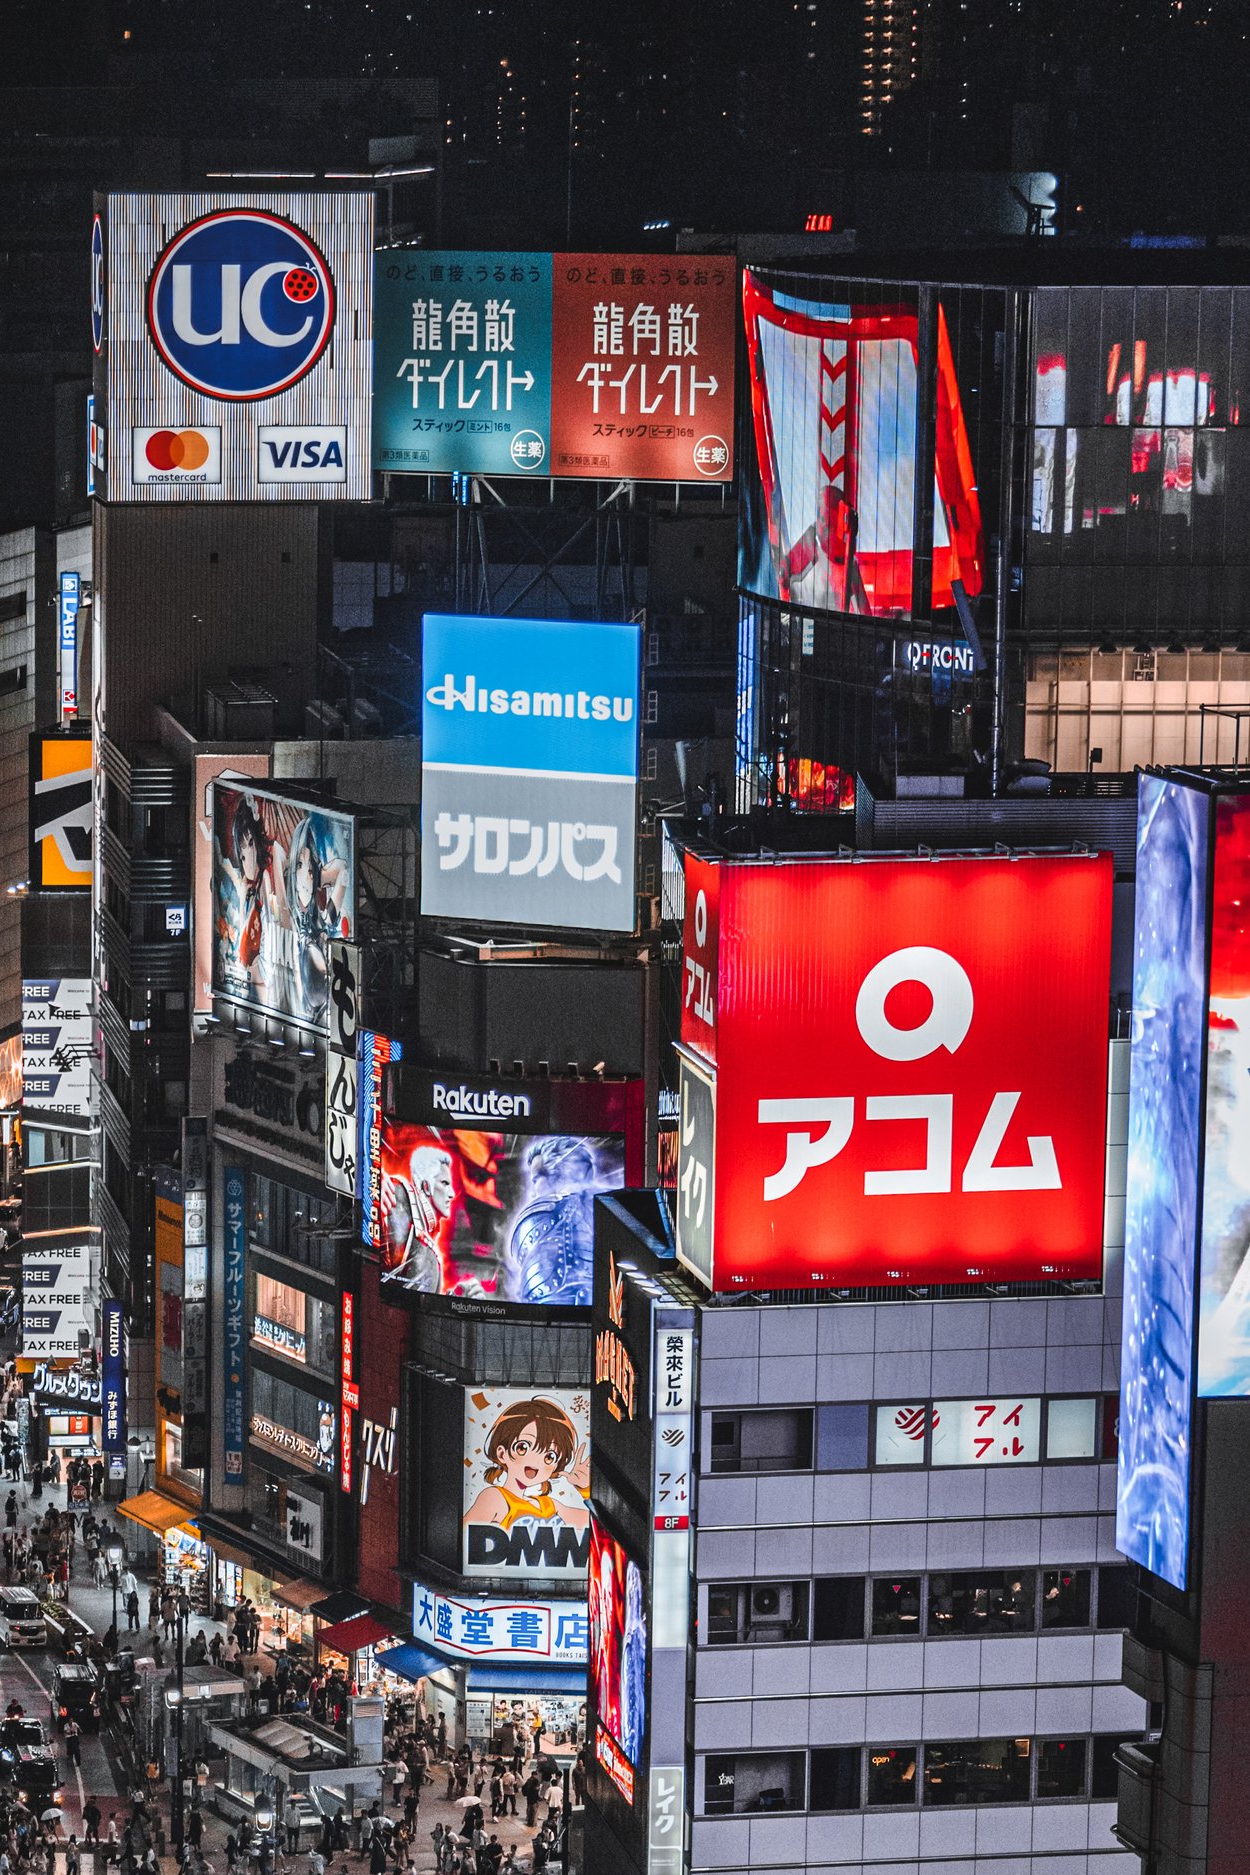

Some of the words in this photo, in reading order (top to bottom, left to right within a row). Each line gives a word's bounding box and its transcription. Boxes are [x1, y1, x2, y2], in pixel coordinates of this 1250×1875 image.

[387, 265, 541, 283] のど、直接、うるおう
[567, 264, 726, 285] のど、直接、うるおう
[412, 298, 516, 353] 龍角散
[593, 302, 700, 357] 龍角散
[396, 359, 535, 411] ダイレクト
[576, 362, 719, 417] ダイレクト
[412, 419, 466, 433] スティック
[592, 424, 647, 438] スティック
[262, 441, 344, 470] VISA
[513, 441, 542, 459] 生薬
[696, 447, 726, 465] 生薬
[147, 473, 207, 482] mastercard
[61, 597, 76, 648] LABI
[426, 674, 632, 722] Hisamitsu
[435, 813, 622, 884] サロンパス
[686, 959, 714, 1028] アコム
[433, 1083, 531, 1117] Rakuten
[758, 1091, 1063, 1202] アコム
[50, 1294, 81, 1304] FREE
[452, 1302, 481, 1314] Rakuten
[482, 1304, 506, 1316] Vision
[109, 1311, 120, 1357] MIZUHO
[107, 1391, 118, 1440] みずほ銀行
[664, 1517, 680, 1528] 8F
[418, 1594, 590, 1650] 大盛堂書店
[655, 1777, 675, 1834] レイク
